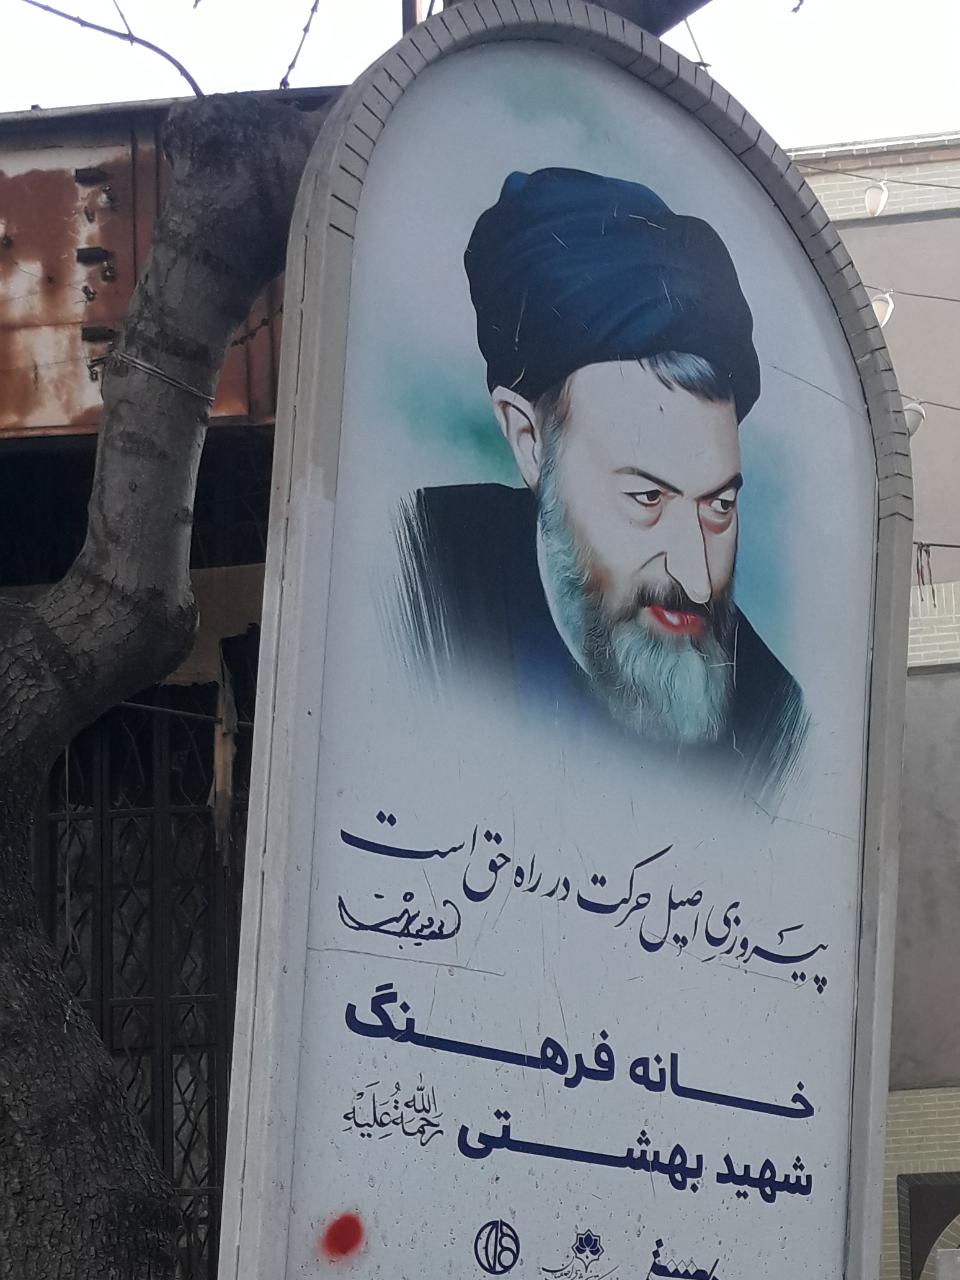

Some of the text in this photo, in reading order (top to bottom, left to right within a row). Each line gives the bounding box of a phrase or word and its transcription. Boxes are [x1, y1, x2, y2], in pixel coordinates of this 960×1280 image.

[340, 810, 829, 994] پیروزی اصیل حرکت در راه حق است
[345, 982, 815, 1118] خانه فرهنگ
[457, 1108, 812, 1203] شهید بهشتی
